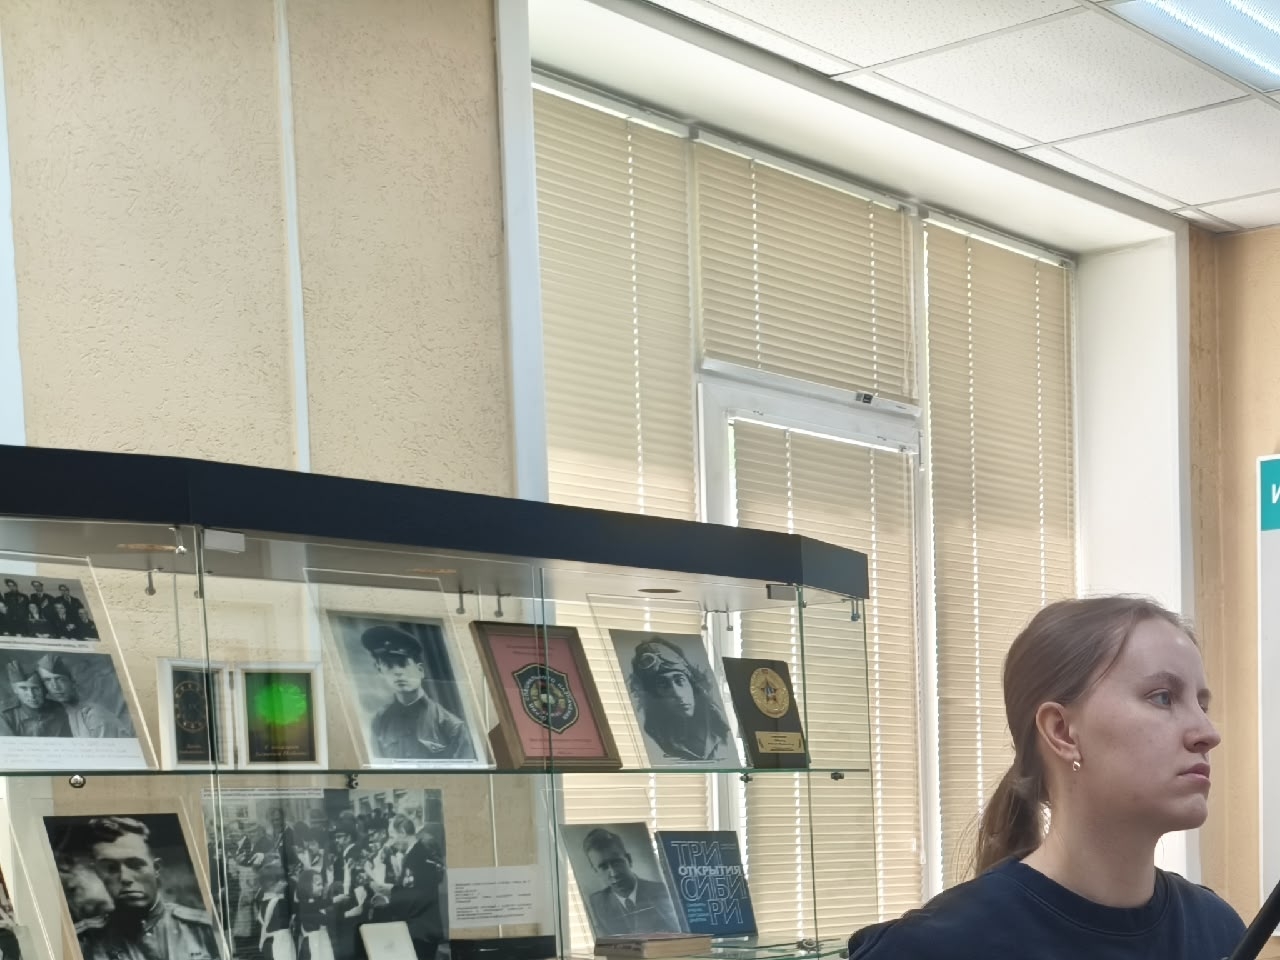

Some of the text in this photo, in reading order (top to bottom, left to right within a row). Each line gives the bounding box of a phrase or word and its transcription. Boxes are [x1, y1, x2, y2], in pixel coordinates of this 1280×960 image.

[671, 841, 722, 866] ТРИ
[678, 866, 741, 876] ОТКРЫТИЯ
[681, 875, 748, 901] СИБИ
[708, 899, 743, 925] РИ
